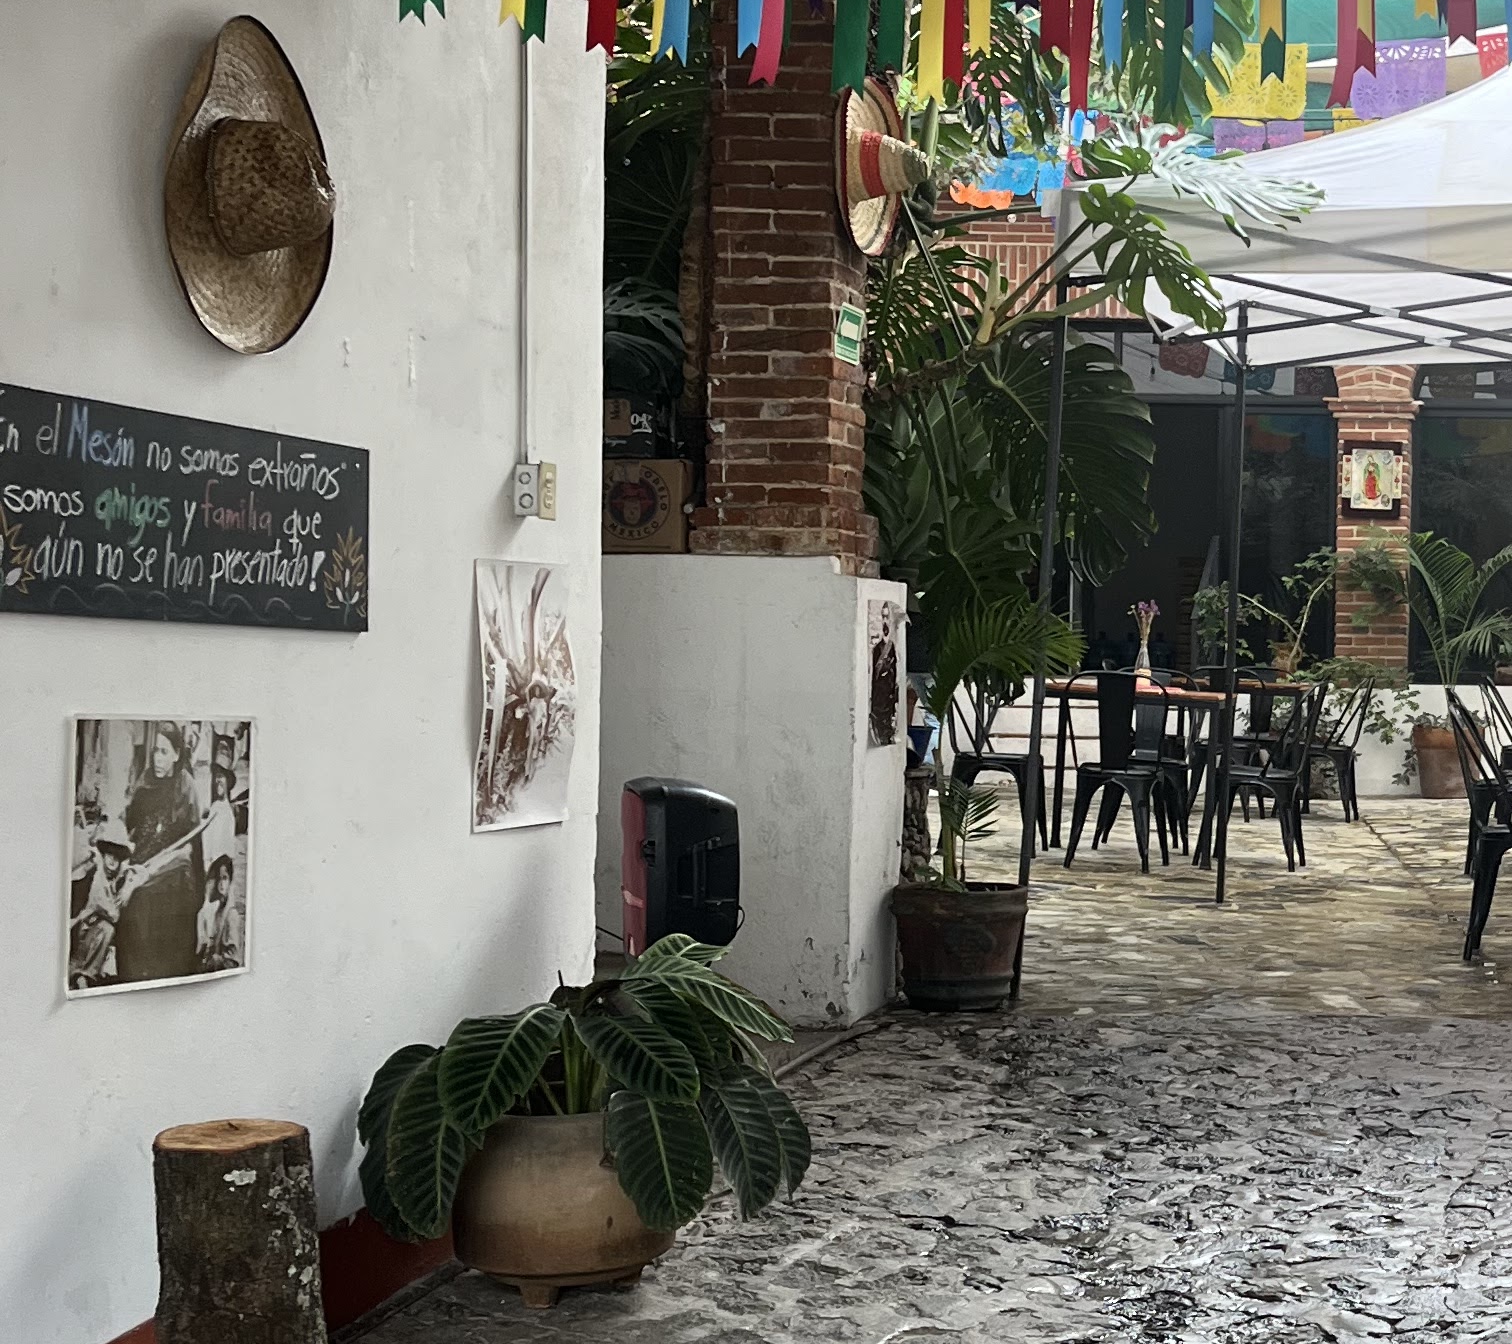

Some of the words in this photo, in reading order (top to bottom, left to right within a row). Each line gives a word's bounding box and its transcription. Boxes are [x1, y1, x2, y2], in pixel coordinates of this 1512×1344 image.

[36, 402, 62, 455] el
[67, 402, 135, 465] Mesón
[147, 441, 172, 472] no
[179, 445, 240, 477] somos
[3, 484, 85, 517] somos
[94, 482, 172, 548] amigos
[181, 499, 197, 547] y
[201, 479, 273, 537] familia
[283, 508, 322, 554] que
[33, 519, 84, 581] aún
[97, 542, 124, 581] no
[128, 545, 158, 583] se
[163, 530, 204, 594] han
[209, 538, 326, 606] presentado!
